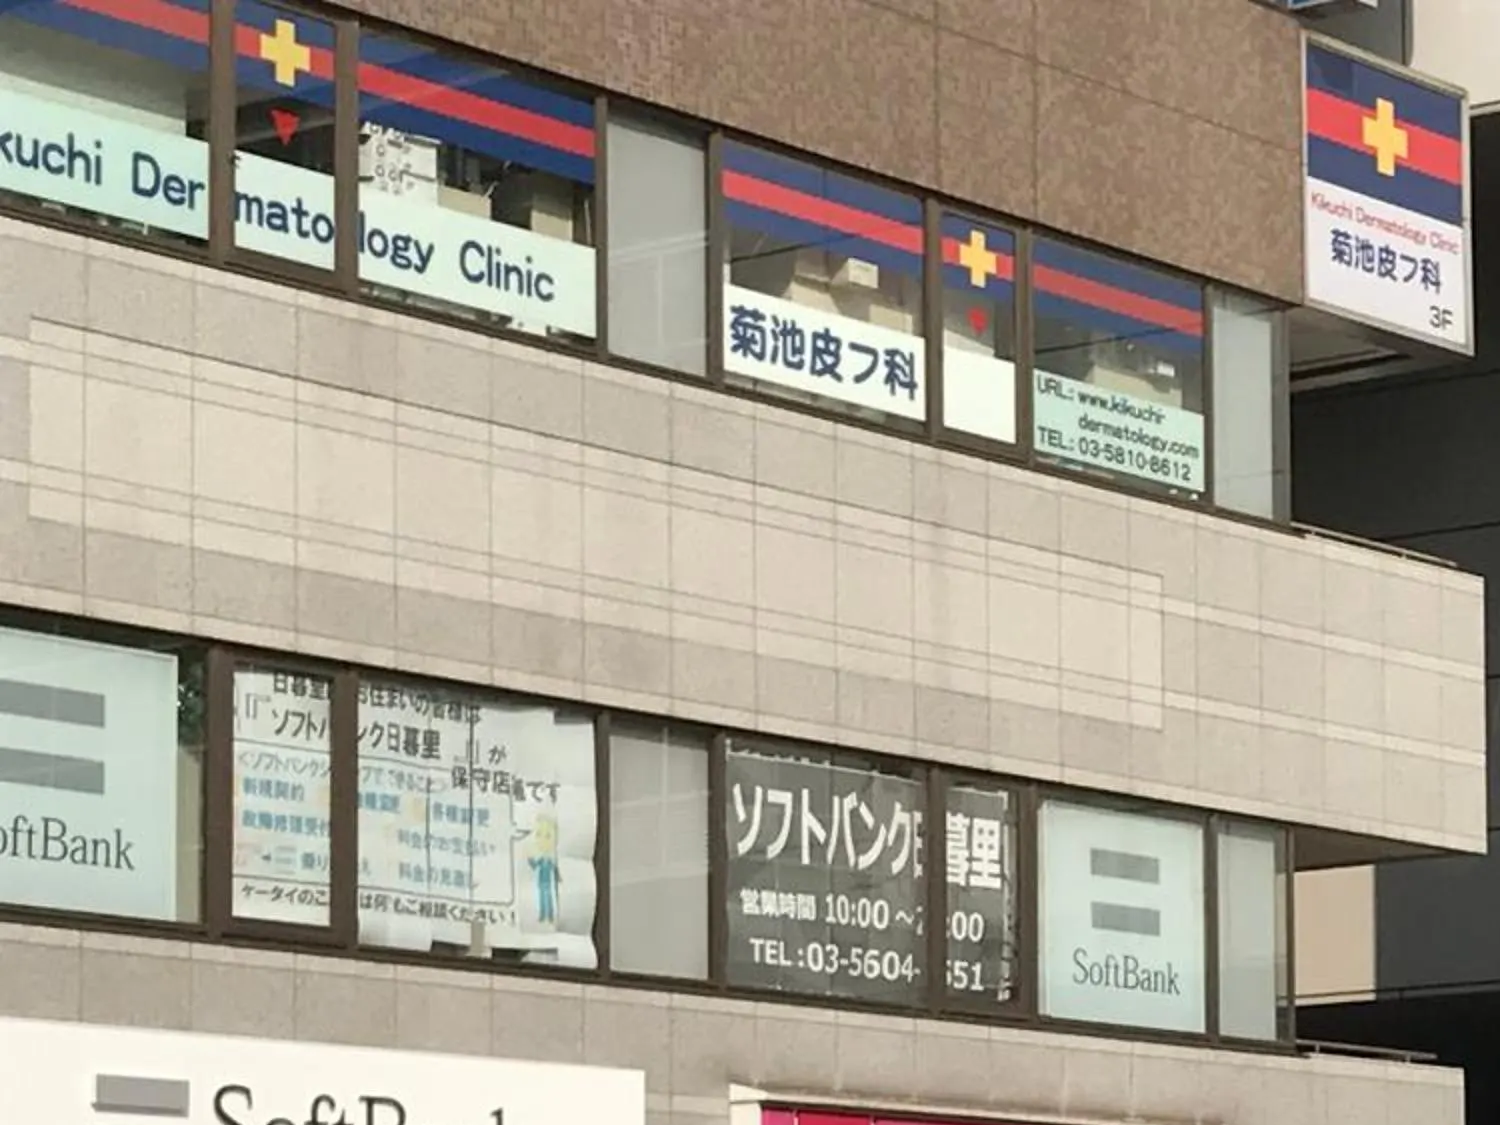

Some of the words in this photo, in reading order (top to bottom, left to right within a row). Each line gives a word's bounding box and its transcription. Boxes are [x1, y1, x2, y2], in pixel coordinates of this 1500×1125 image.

[1311, 191, 1353, 219] Kikuchi
[1355, 206, 1426, 245] Dermatology
[1429, 230, 1460, 256] Clinic
[459, 239, 555, 302] Clinic
[1330, 228, 1441, 294] 菊池皮フ科
[1429, 305, 1453, 330] 3F
[729, 304, 918, 401] 菊池皮フ科
[1072, 948, 1181, 997] SoftBank
